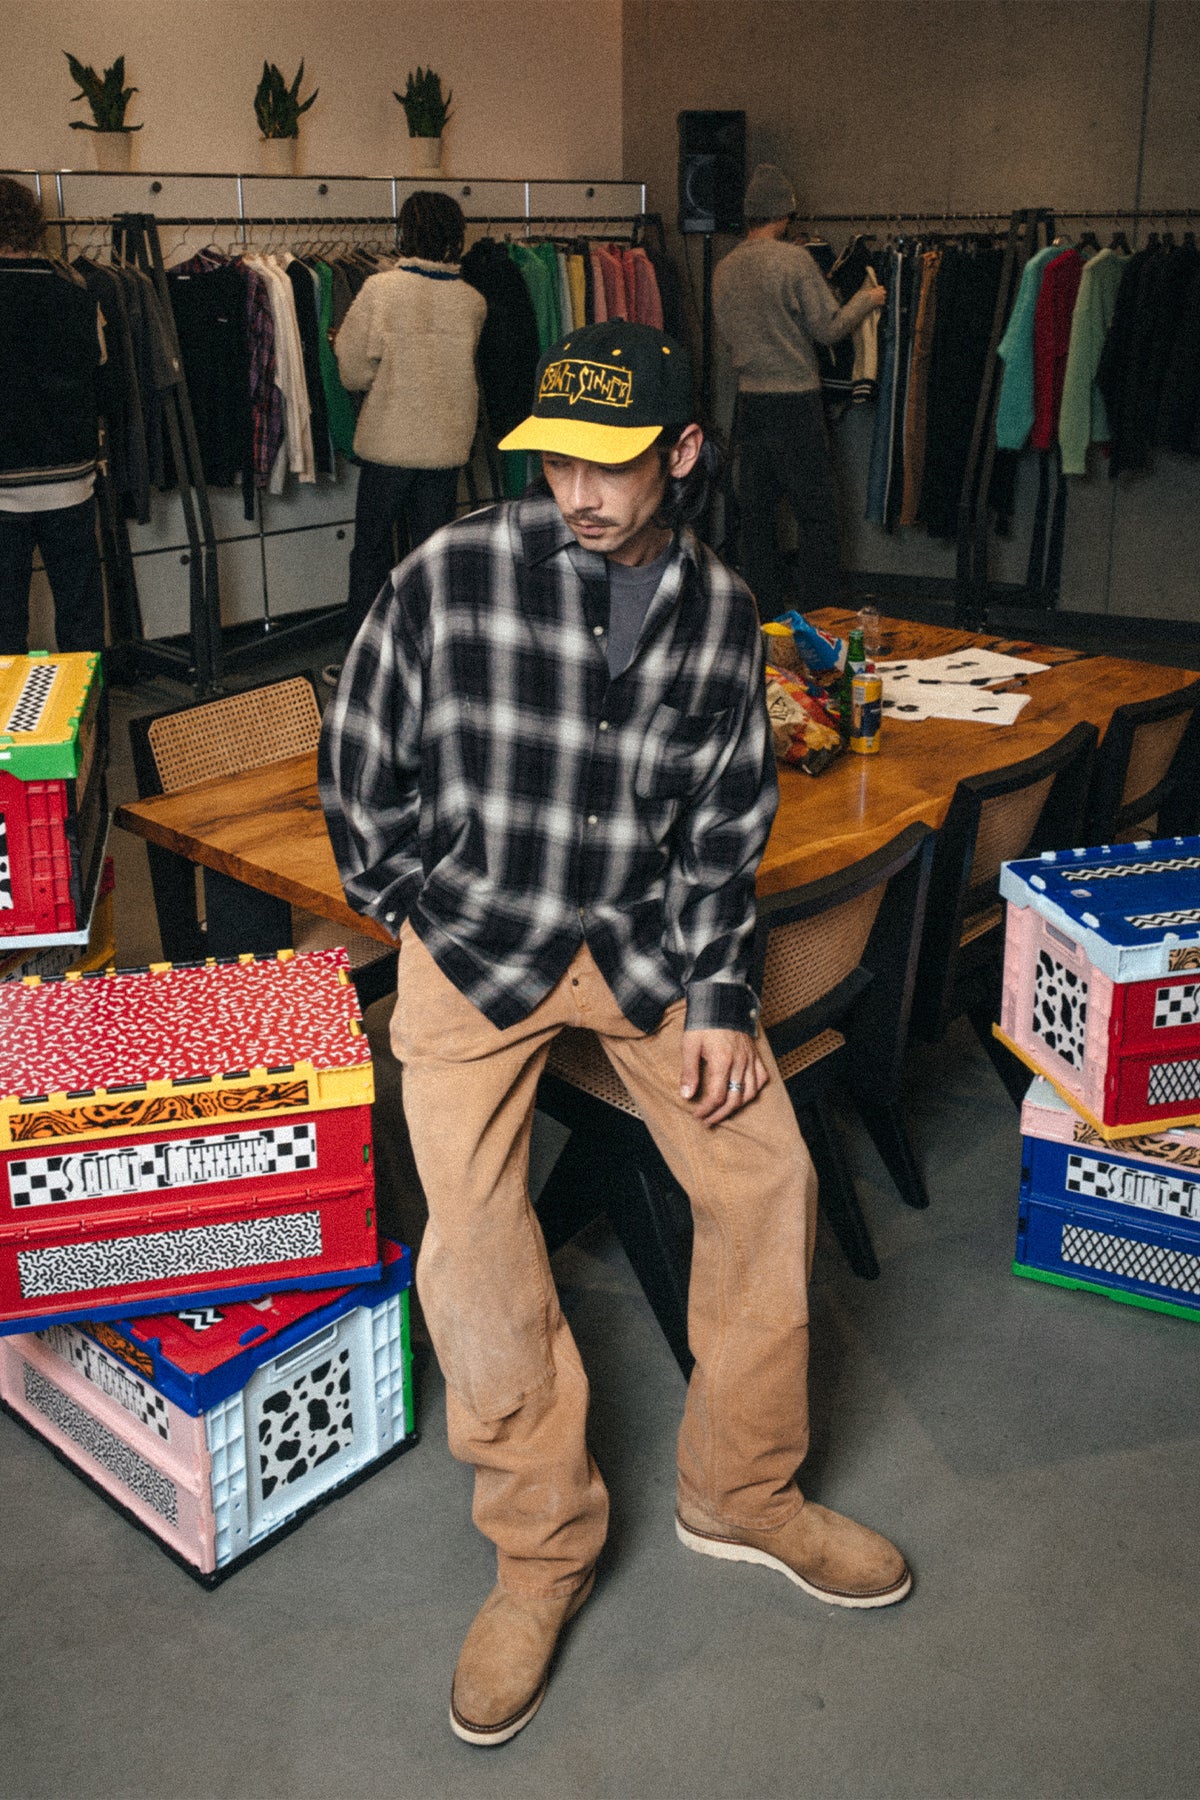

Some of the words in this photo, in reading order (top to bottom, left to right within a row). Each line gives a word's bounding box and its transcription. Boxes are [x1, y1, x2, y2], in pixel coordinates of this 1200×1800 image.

[569, 366, 629, 405] SINNER
[61, 1151, 142, 1198] SAINT
[1107, 1166, 1171, 1211] SAINT
